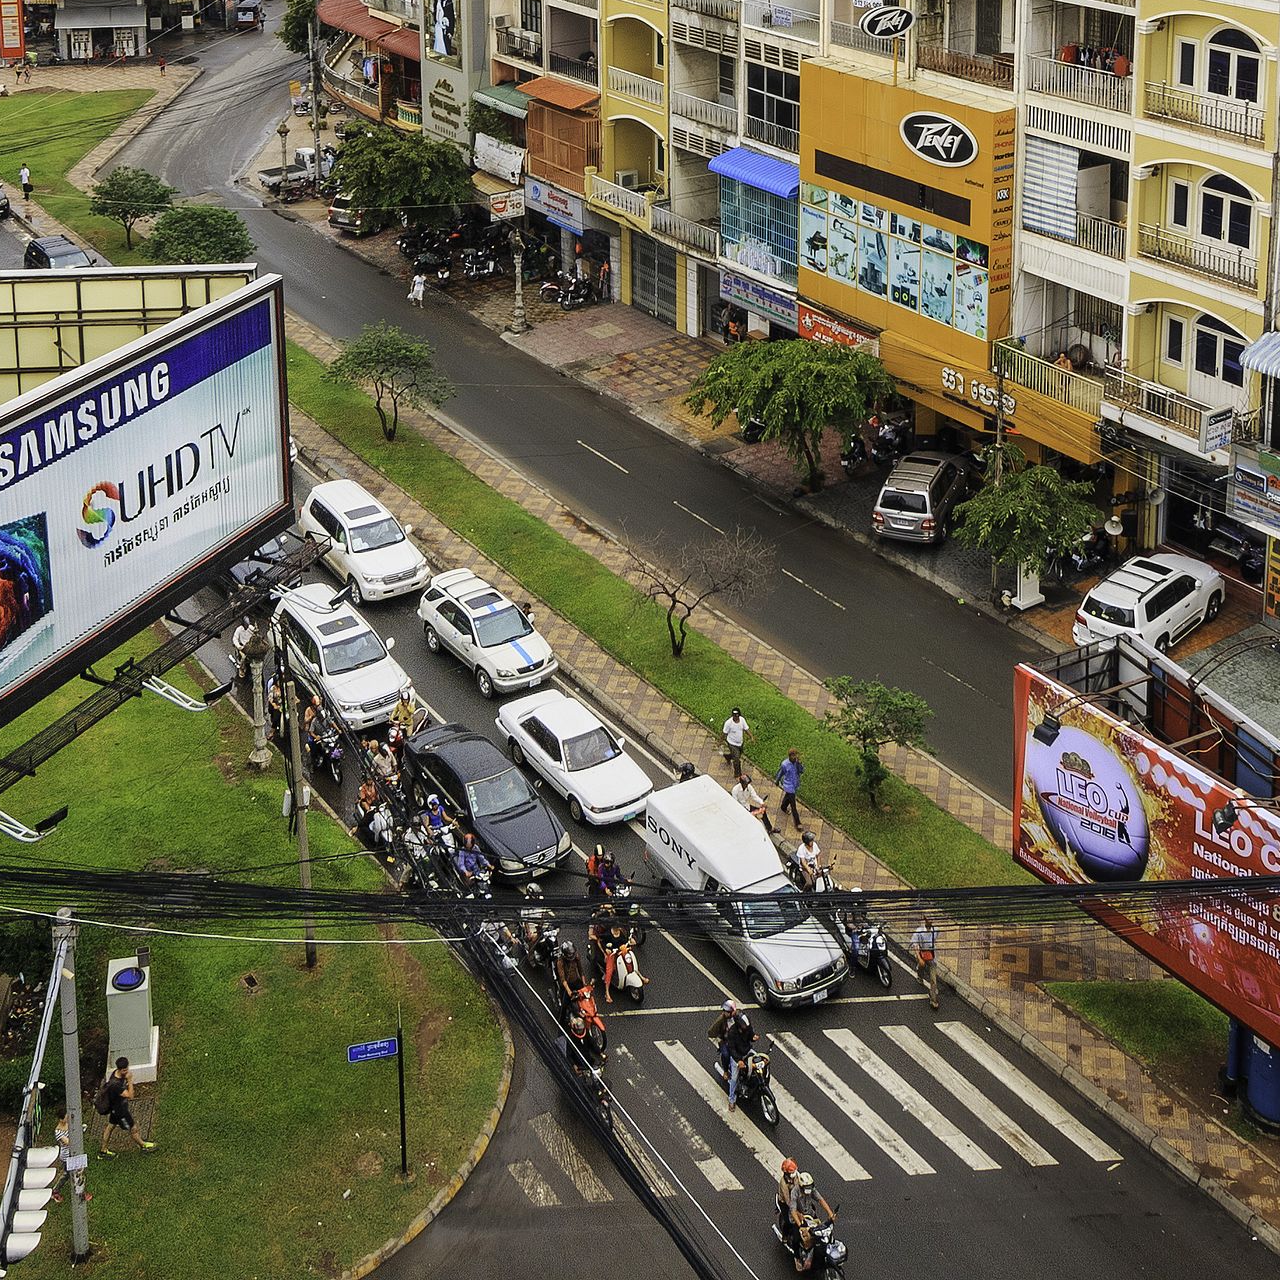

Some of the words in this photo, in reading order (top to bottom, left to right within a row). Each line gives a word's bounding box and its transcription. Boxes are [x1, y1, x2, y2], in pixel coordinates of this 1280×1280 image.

[989, 284, 1010, 294] CASIO
[1055, 767, 1108, 815] LEO
[1108, 808, 1129, 822] CUP
[1057, 796, 1085, 815] National
[1084, 805, 1117, 829] Volleyball
[647, 815, 697, 870] SONY
[1080, 817, 1116, 841] 2016
[1195, 811, 1253, 858] LEO
[1192, 841, 1253, 877] National
